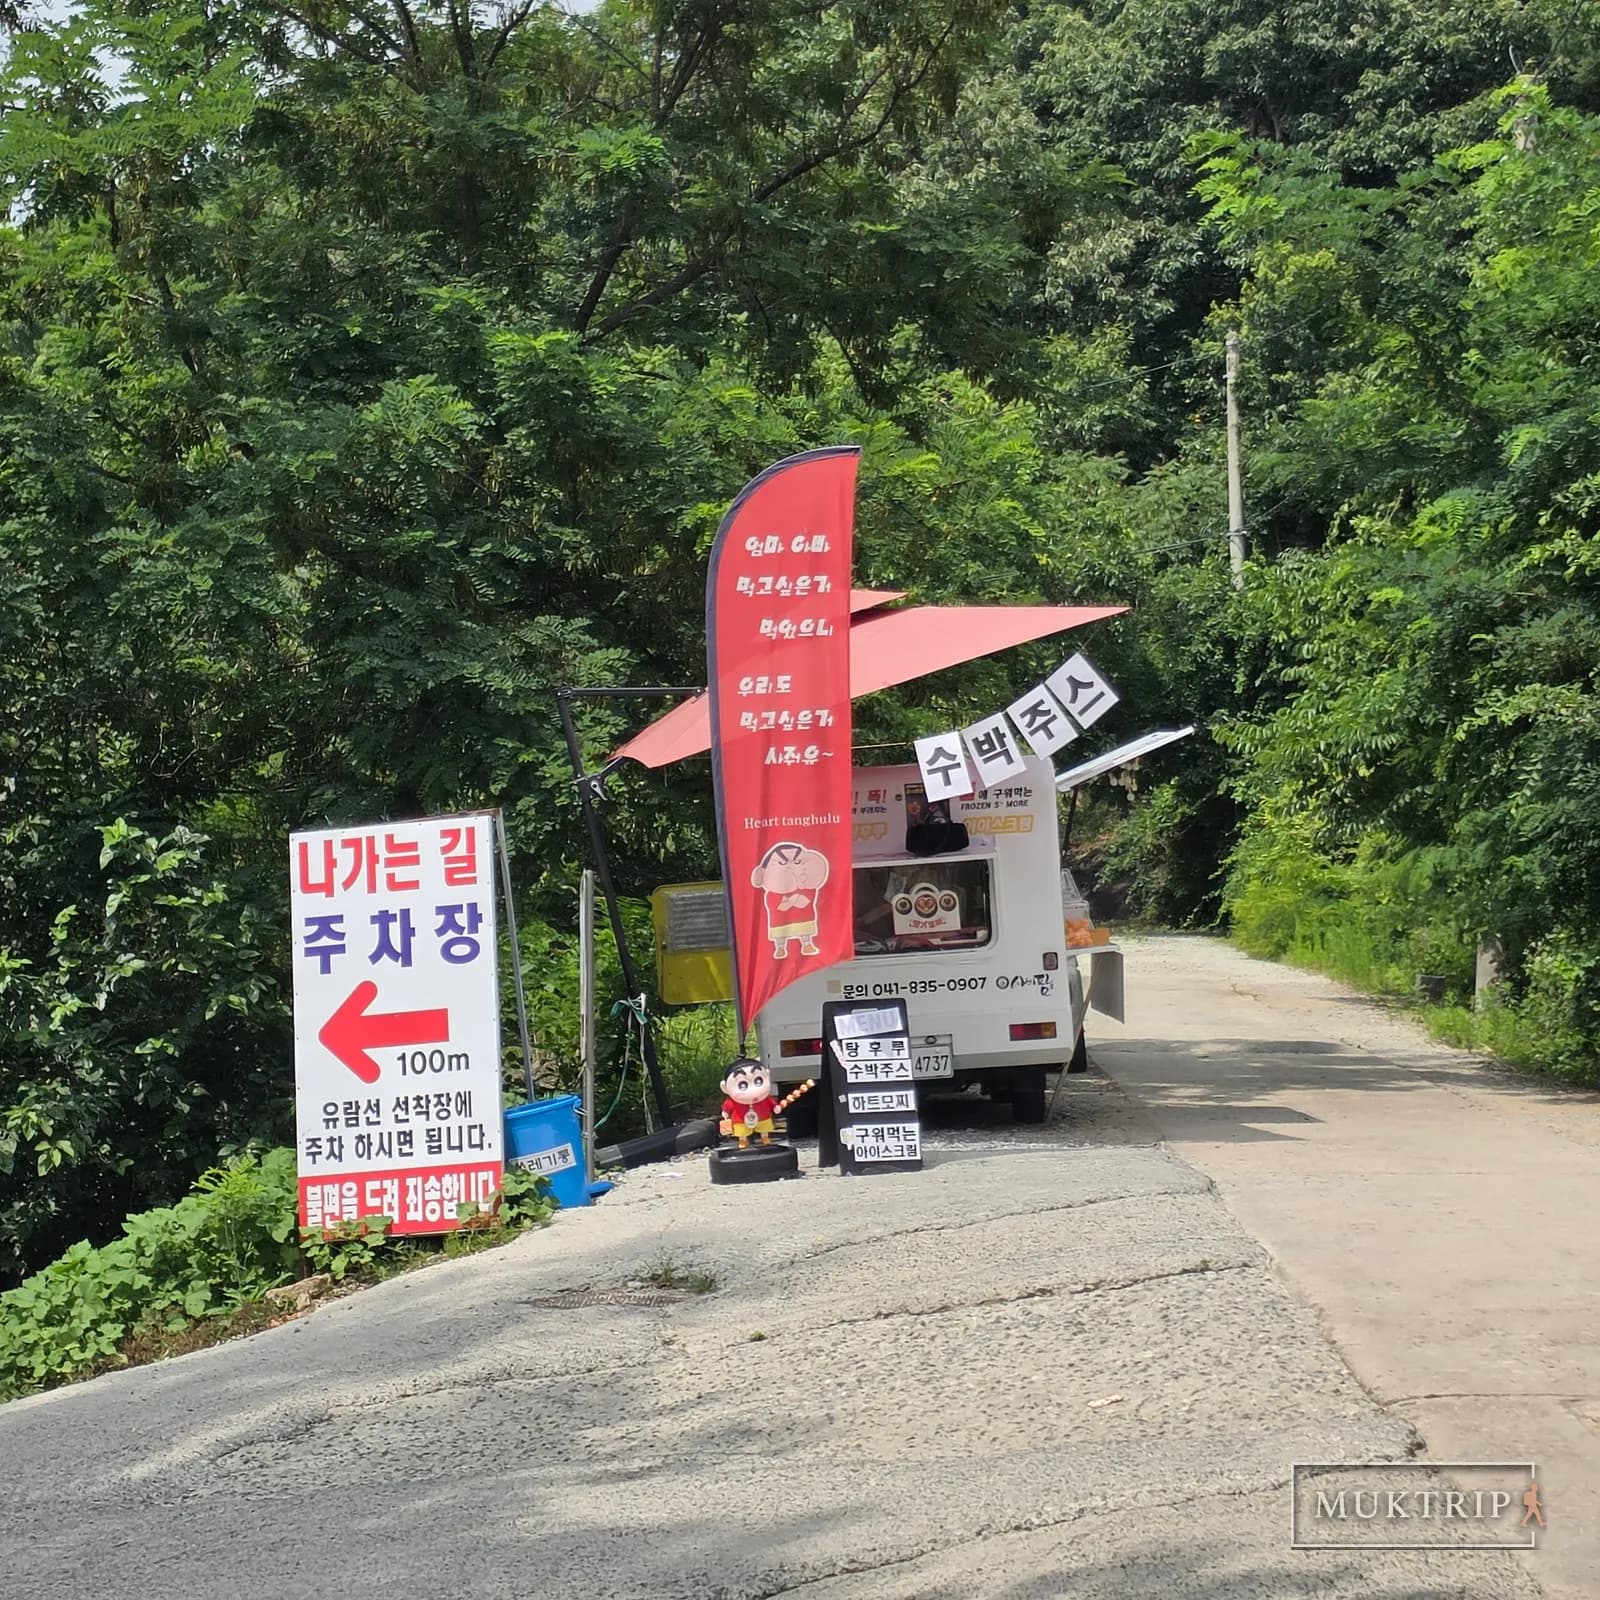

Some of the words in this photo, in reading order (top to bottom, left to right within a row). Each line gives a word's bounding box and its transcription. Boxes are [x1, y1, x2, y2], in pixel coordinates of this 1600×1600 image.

[745, 535, 784, 557] 엄마
[791, 534, 831, 553] 아빠
[760, 619, 833, 640] 먹었으니
[926, 674, 1106, 787] 수박주스
[993, 786, 1033, 799] 구워먹는
[961, 801, 992, 811] FROZEN
[1005, 799, 1029, 808] MORE
[744, 815, 779, 830] Heart
[782, 812, 840, 828] tanghulu
[298, 833, 421, 898] 나가는
[439, 826, 478, 885] 길
[843, 984, 868, 999] 문의
[873, 976, 987, 996] 041-835-0907
[396, 1050, 470, 1077] 100m
[849, 1062, 910, 1080] 수박주스
[914, 1055, 949, 1073] 4737
[322, 1101, 382, 1129] 유람선
[391, 1092, 473, 1125] 선착장에
[852, 1094, 909, 1111] 하트모찌
[305, 1136, 345, 1165] 주차
[355, 1131, 414, 1160] 하시면
[424, 1123, 492, 1155] 됩니다.
[856, 1126, 917, 1144] 구워먹는
[856, 1143, 918, 1158] 아이스크림
[306, 1182, 358, 1230] 불편을
[406, 1170, 495, 1222] 죄송합니다
